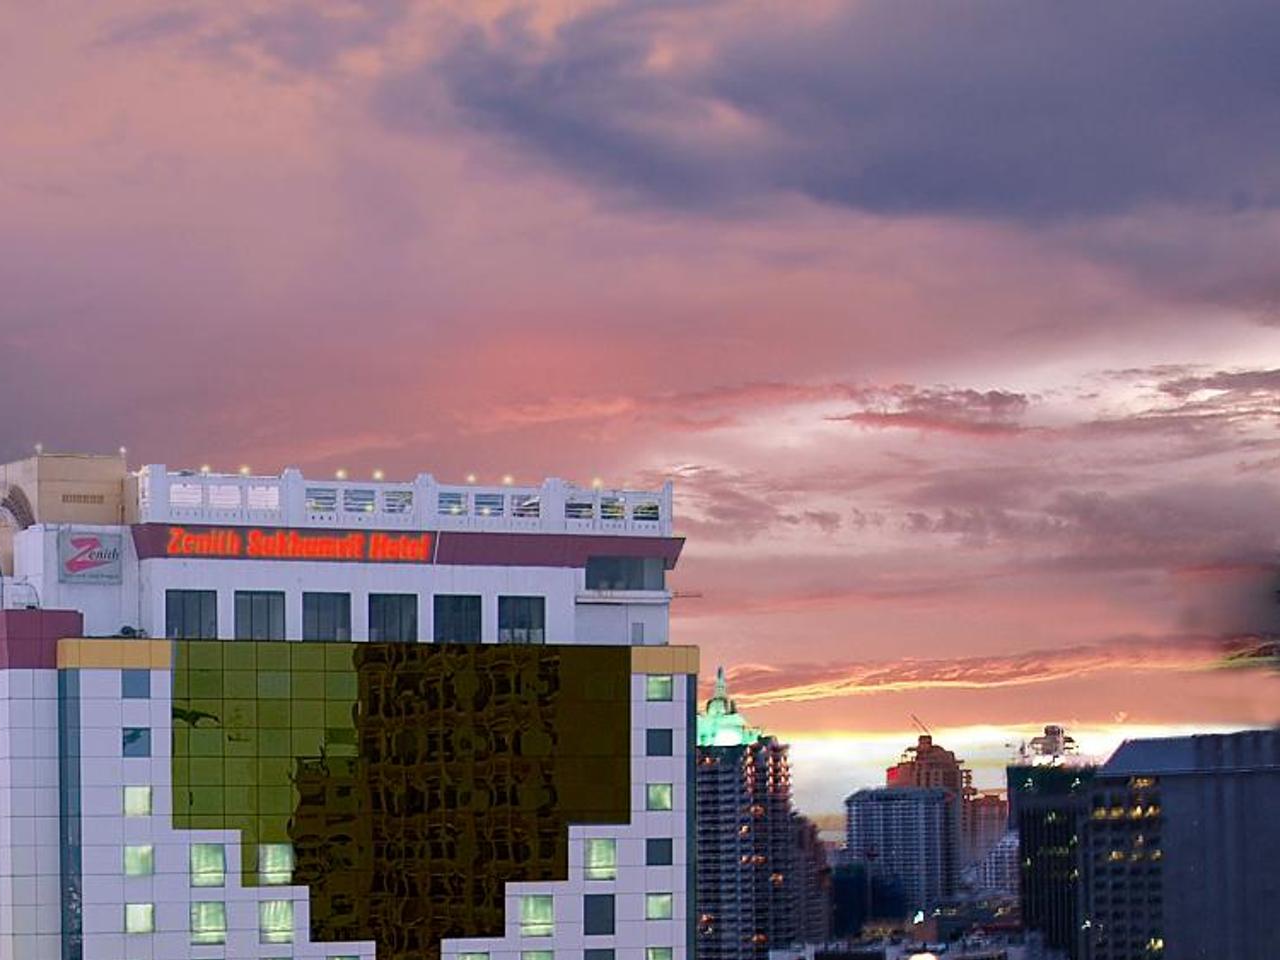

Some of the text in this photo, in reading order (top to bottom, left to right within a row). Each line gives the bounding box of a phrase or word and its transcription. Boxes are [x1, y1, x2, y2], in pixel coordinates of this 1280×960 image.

[64, 537, 120, 574] Zenith
[166, 527, 241, 556] Zenith
[368, 532, 431, 561] Hotel
